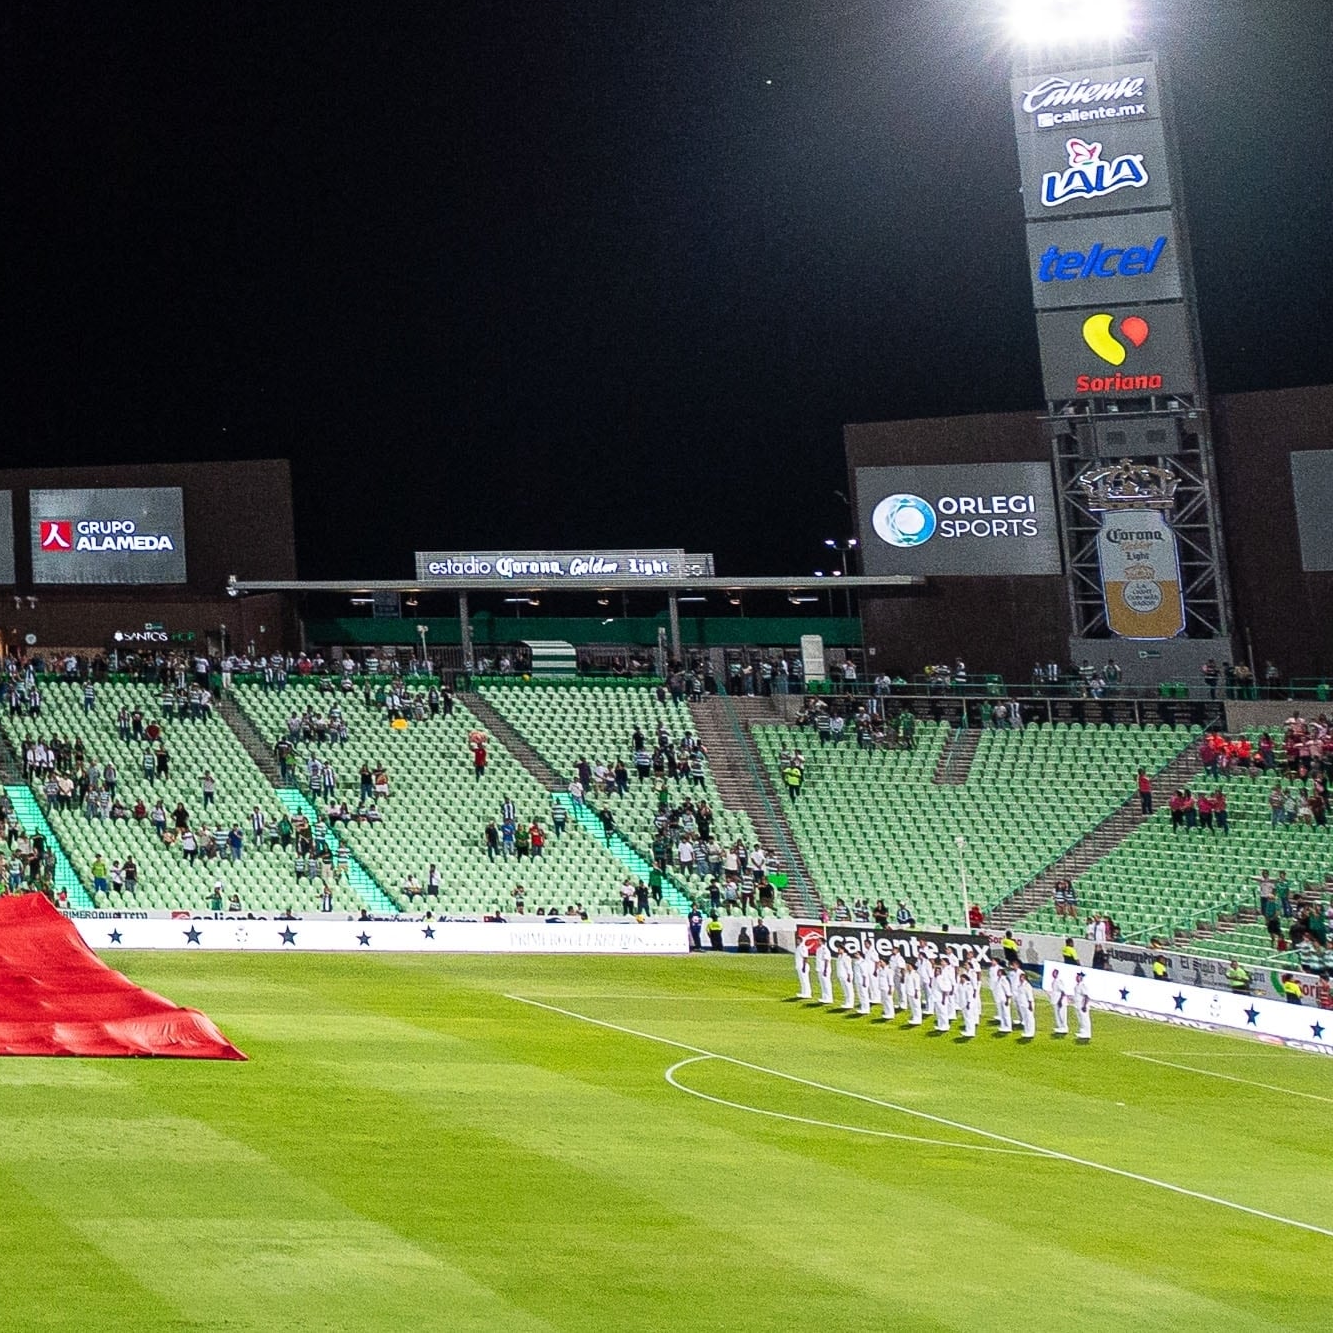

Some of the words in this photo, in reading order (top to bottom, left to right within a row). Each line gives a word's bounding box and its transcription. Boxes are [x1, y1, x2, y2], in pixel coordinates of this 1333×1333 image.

[1023, 77, 1144, 113] Caliente
[1053, 102, 1146, 125] caliente.mx
[1041, 155, 1149, 206] LALA
[1037, 235, 1168, 284] telcel
[1076, 372, 1163, 394] Soriana
[938, 495, 1035, 515] ORLEGI
[76, 520, 136, 536] GRUPO
[939, 517, 1038, 539] SPORTS
[1106, 528, 1166, 545] Corona
[76, 534, 174, 552] ALAMEDA
[428, 556, 491, 575] estadio
[495, 557, 565, 578] Corona
[569, 556, 619, 576] Golden
[628, 558, 670, 576] Light
[123, 631, 169, 642] SANTOS
